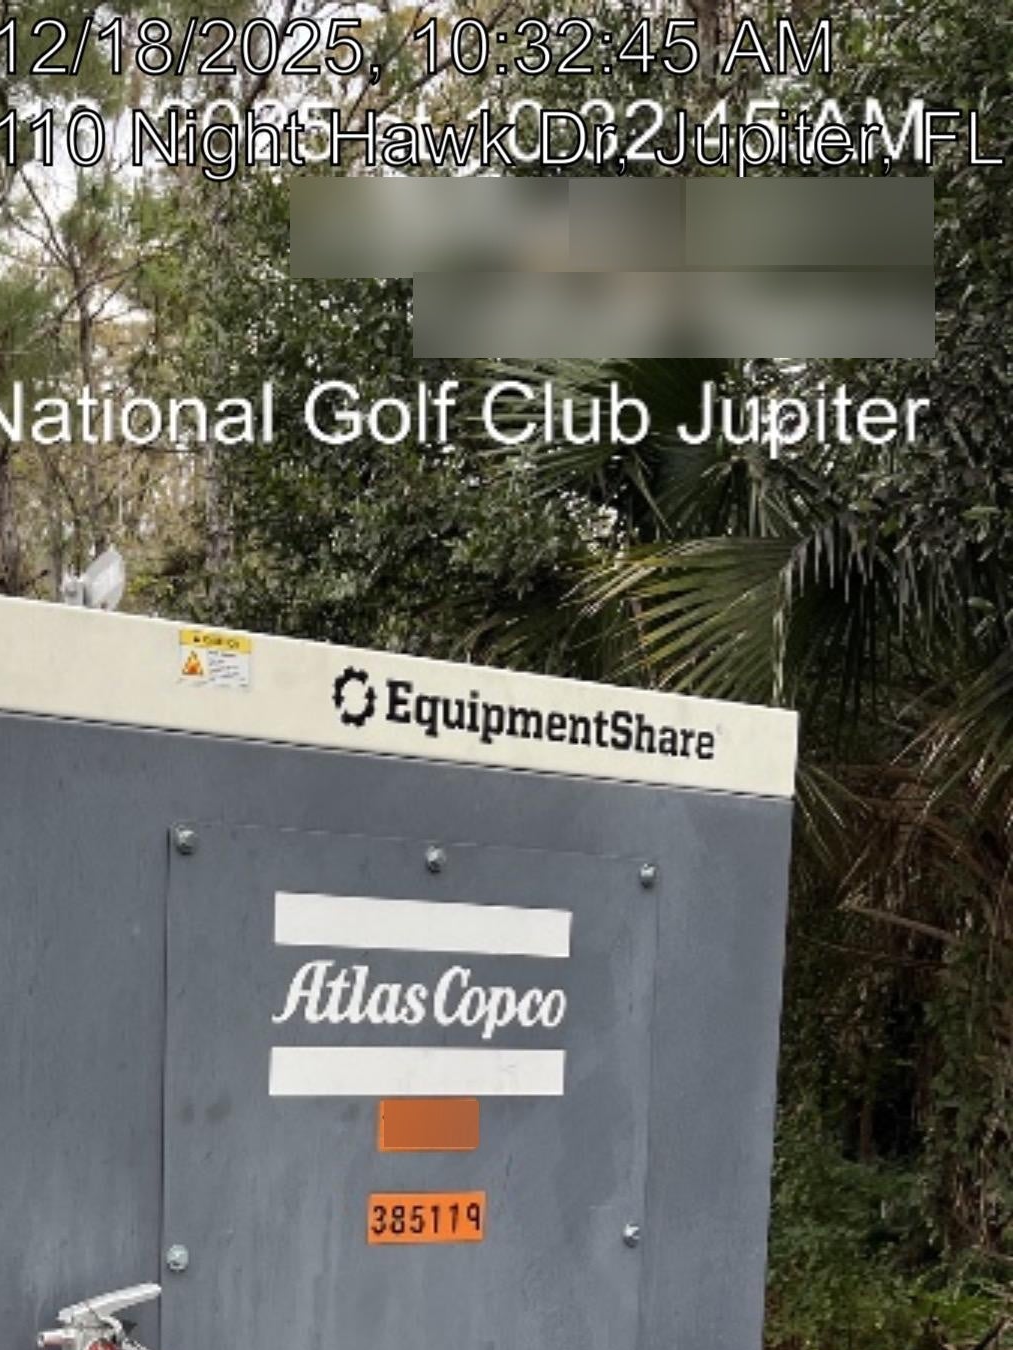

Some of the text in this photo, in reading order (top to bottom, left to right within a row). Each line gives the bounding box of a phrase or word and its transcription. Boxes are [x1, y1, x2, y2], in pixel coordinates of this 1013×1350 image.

[385, 679, 717, 761] EquipmentShare
[271, 959, 568, 1040] Atlas Copco
[370, 1202, 483, 1235] 385119
